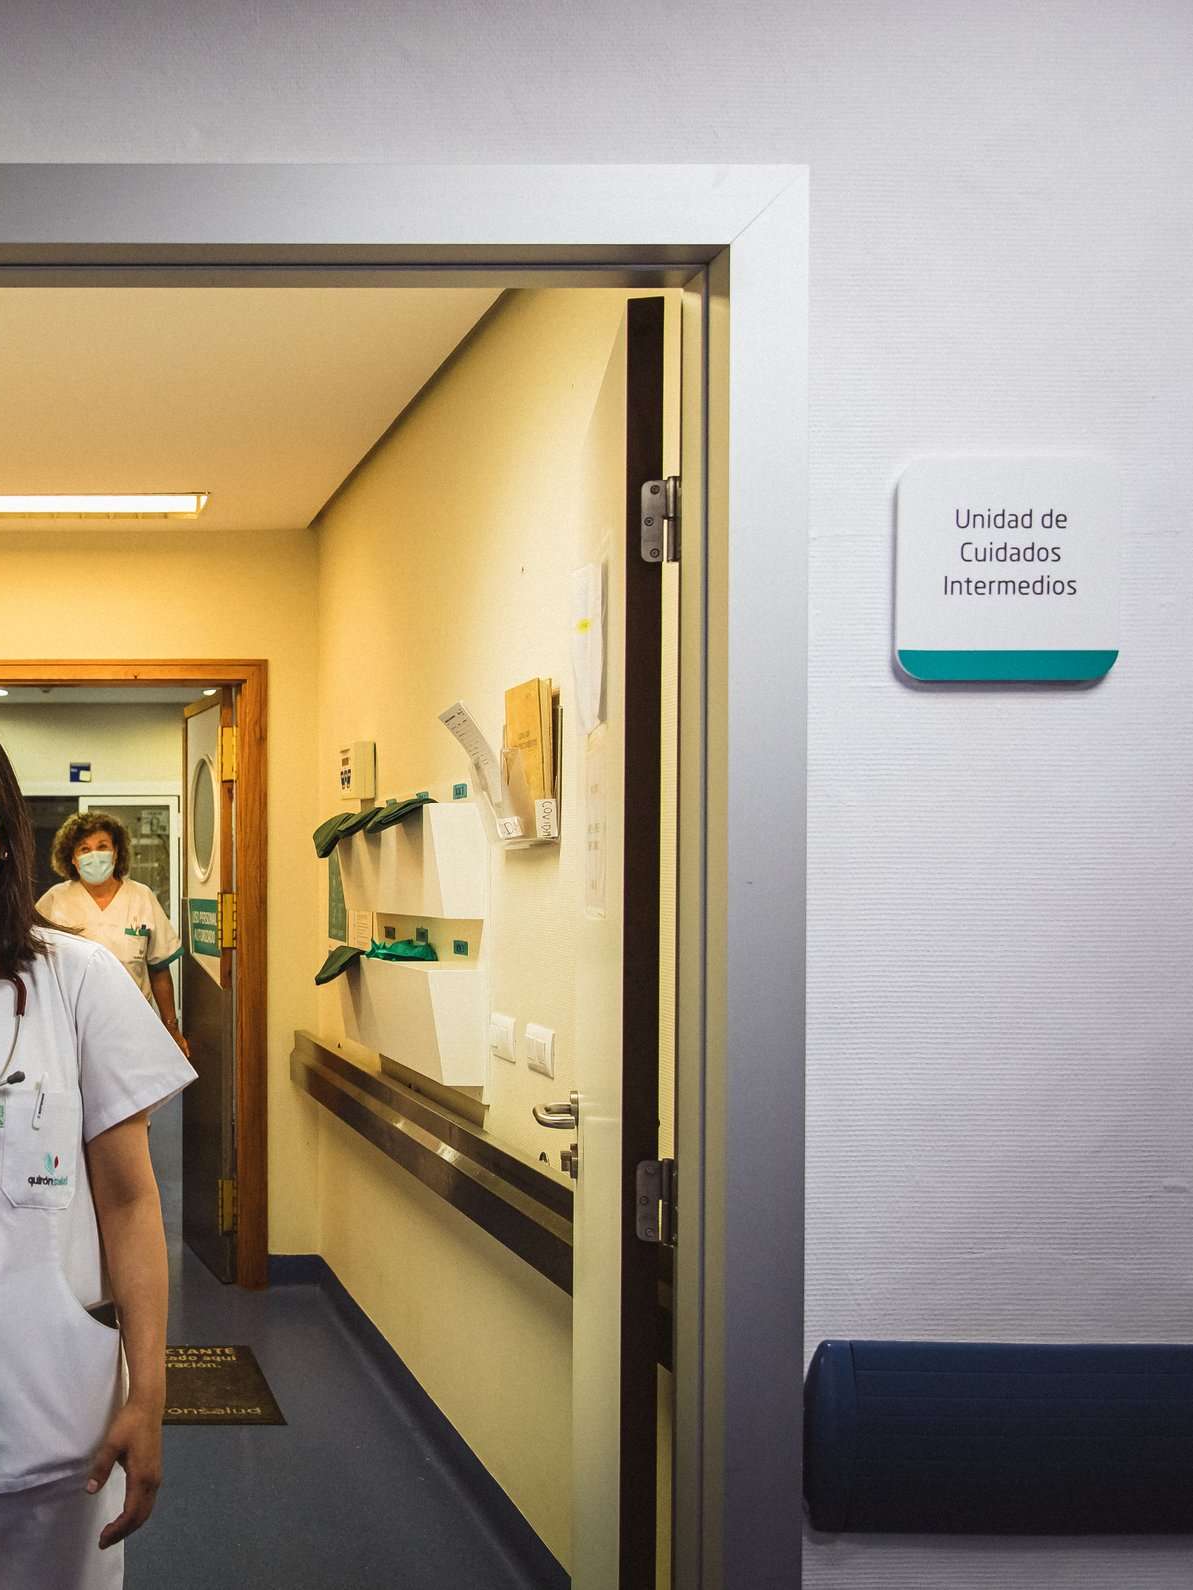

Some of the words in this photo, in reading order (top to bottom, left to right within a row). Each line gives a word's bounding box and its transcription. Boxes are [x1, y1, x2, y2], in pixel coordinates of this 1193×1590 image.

[955, 508, 1033, 529] Unidad
[1041, 508, 1068, 529] de
[960, 541, 1061, 562] Cuidados
[943, 575, 1077, 596] Intermedios
[166, 1407, 262, 1415] onsalud
